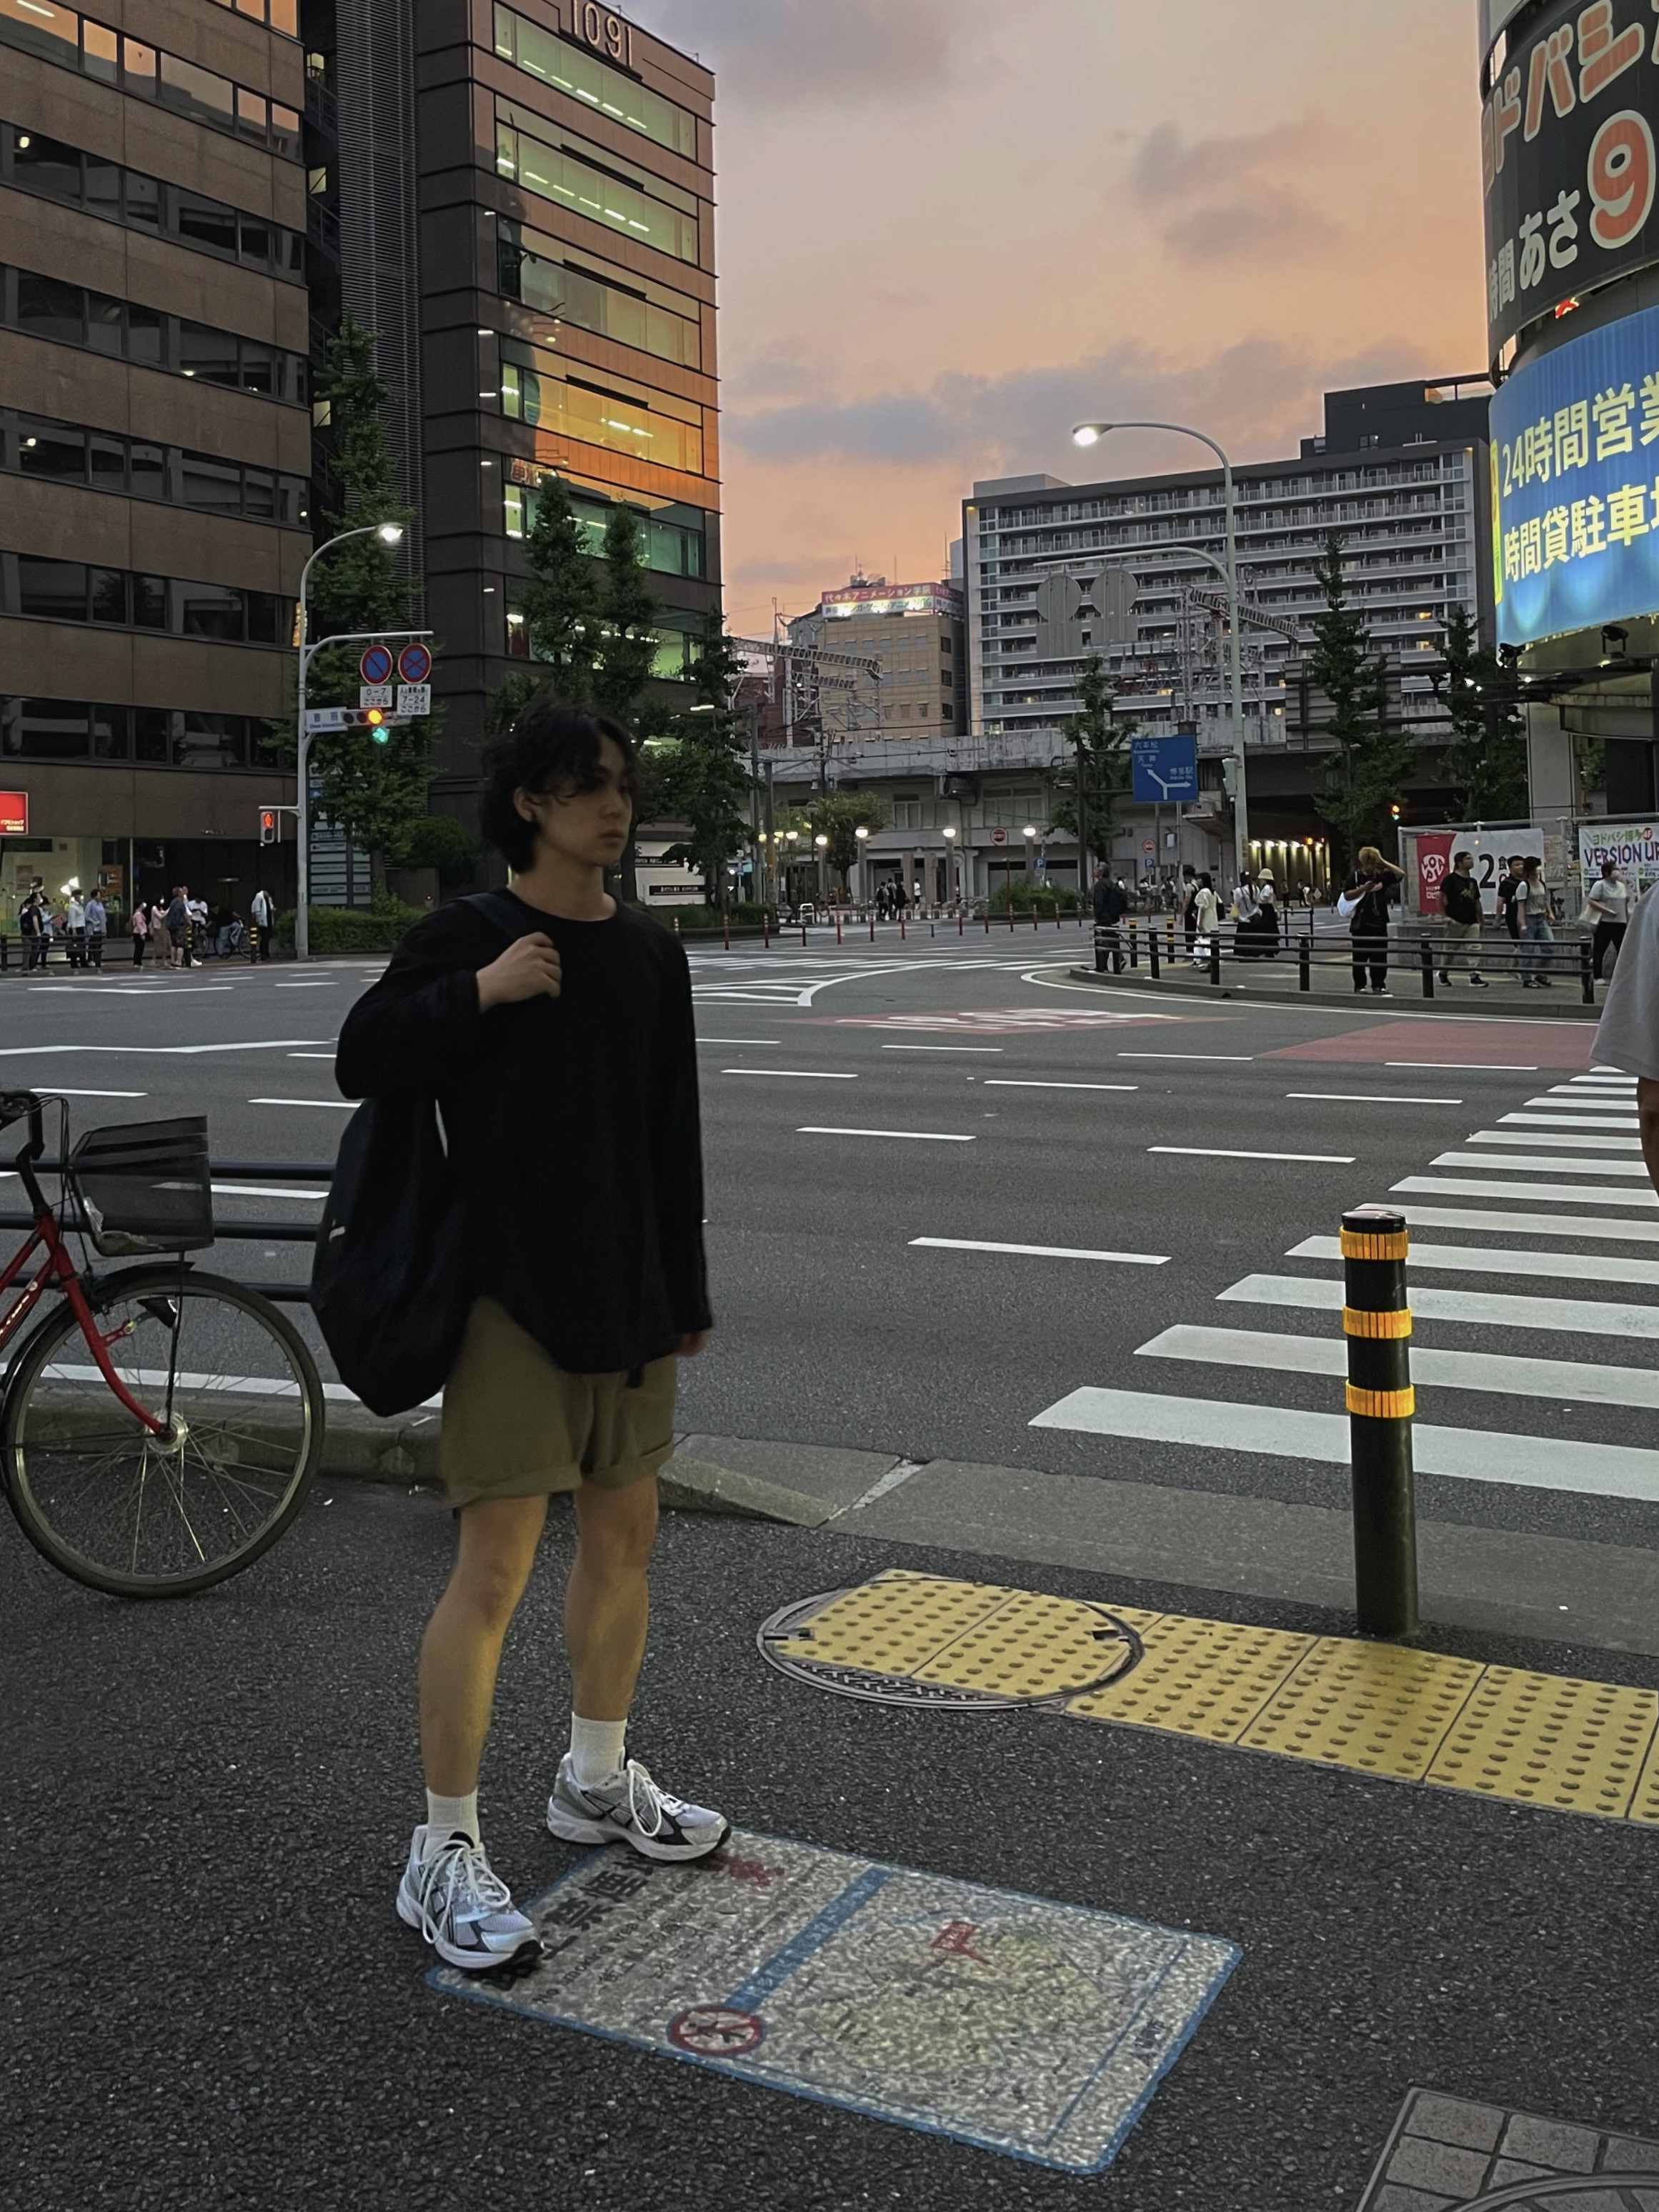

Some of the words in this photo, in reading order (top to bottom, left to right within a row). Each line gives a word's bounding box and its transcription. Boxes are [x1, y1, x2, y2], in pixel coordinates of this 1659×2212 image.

[1504, 476, 1659, 582] 時間貸駐車
[1584, 842, 1642, 867] VERSION
